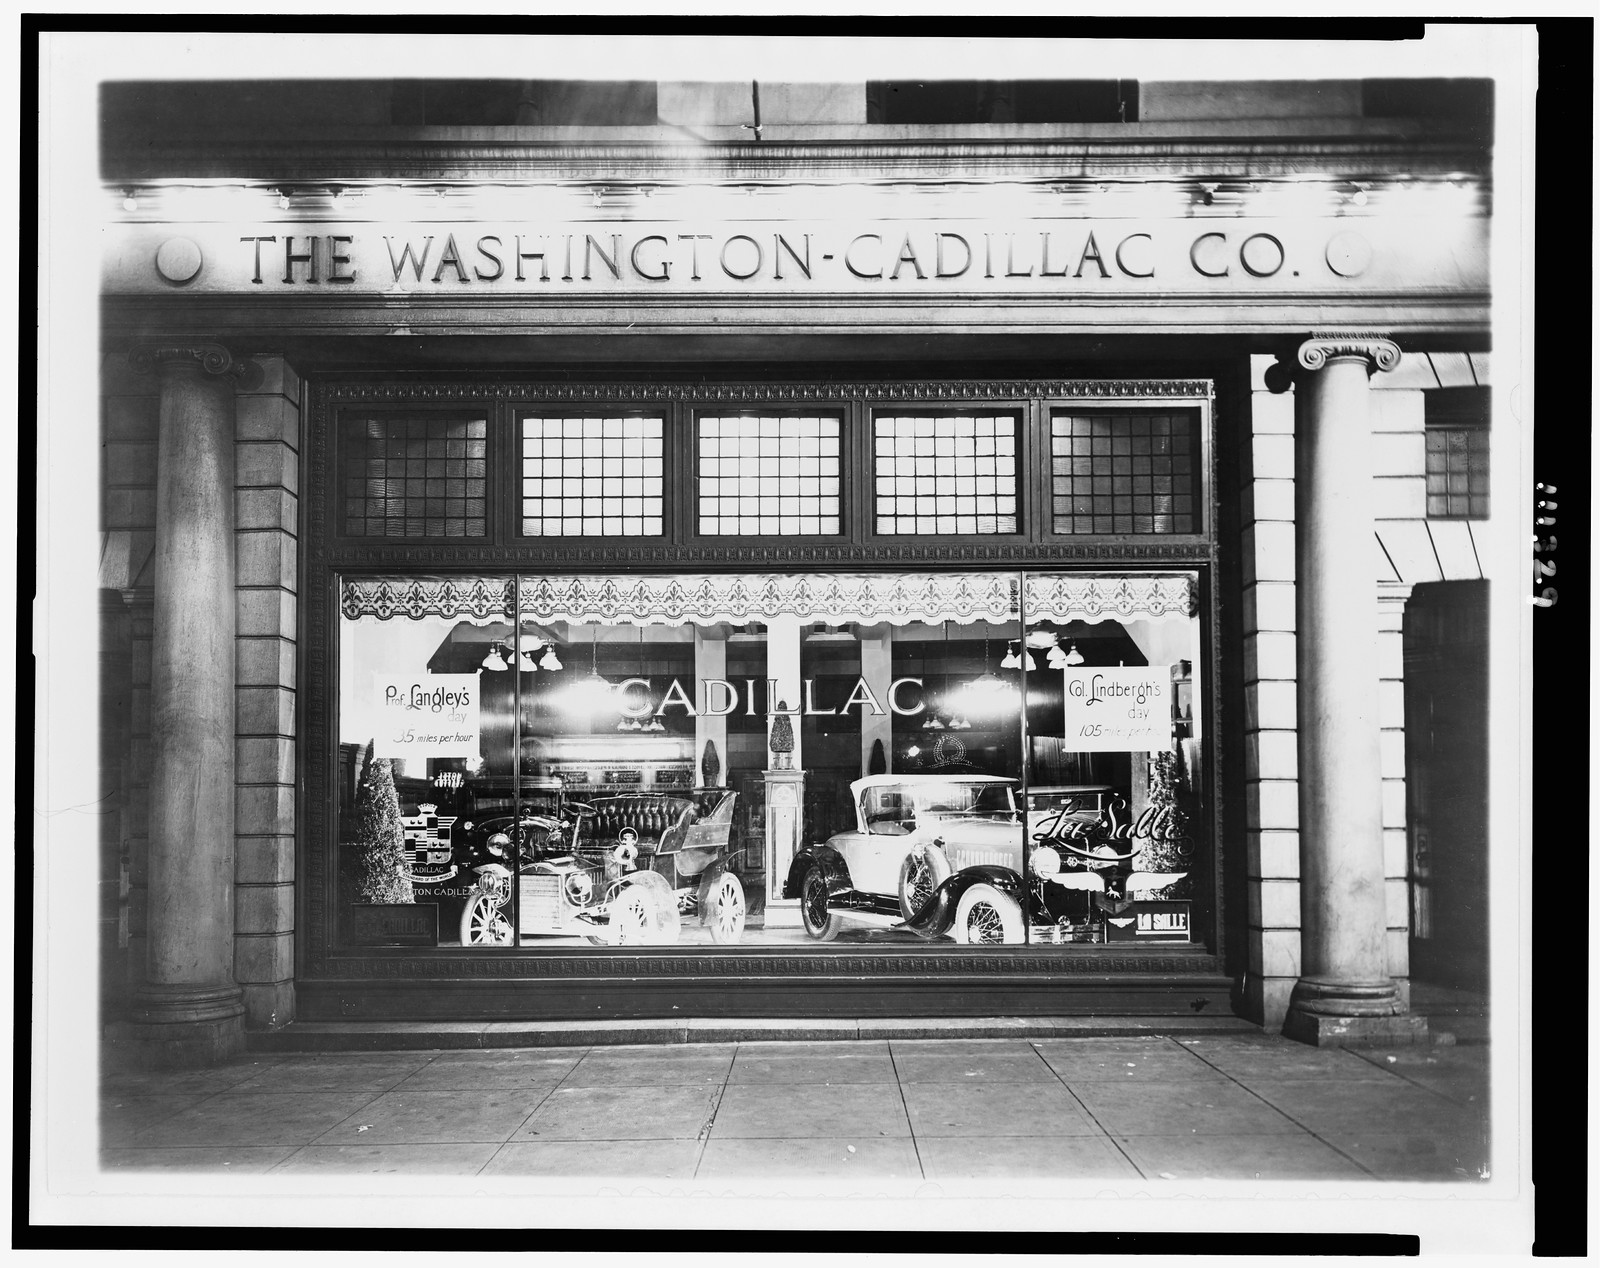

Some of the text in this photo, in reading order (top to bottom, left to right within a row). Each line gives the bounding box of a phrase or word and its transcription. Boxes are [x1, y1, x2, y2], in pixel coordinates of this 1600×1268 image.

[240, 231, 1299, 285] THE WASHINGTON-CADILLAC CO.
[385, 683, 470, 713] Prof. Langley's
[614, 677, 926, 717] CADILLAC
[1069, 674, 1161, 706] Col. Lindbergh's
[447, 707, 467, 724] day
[1127, 702, 1150, 720] day
[392, 728, 474, 745] 35 miles per hour
[1079, 724, 1102, 737] 105
[433, 888, 477, 896] CADILLA
